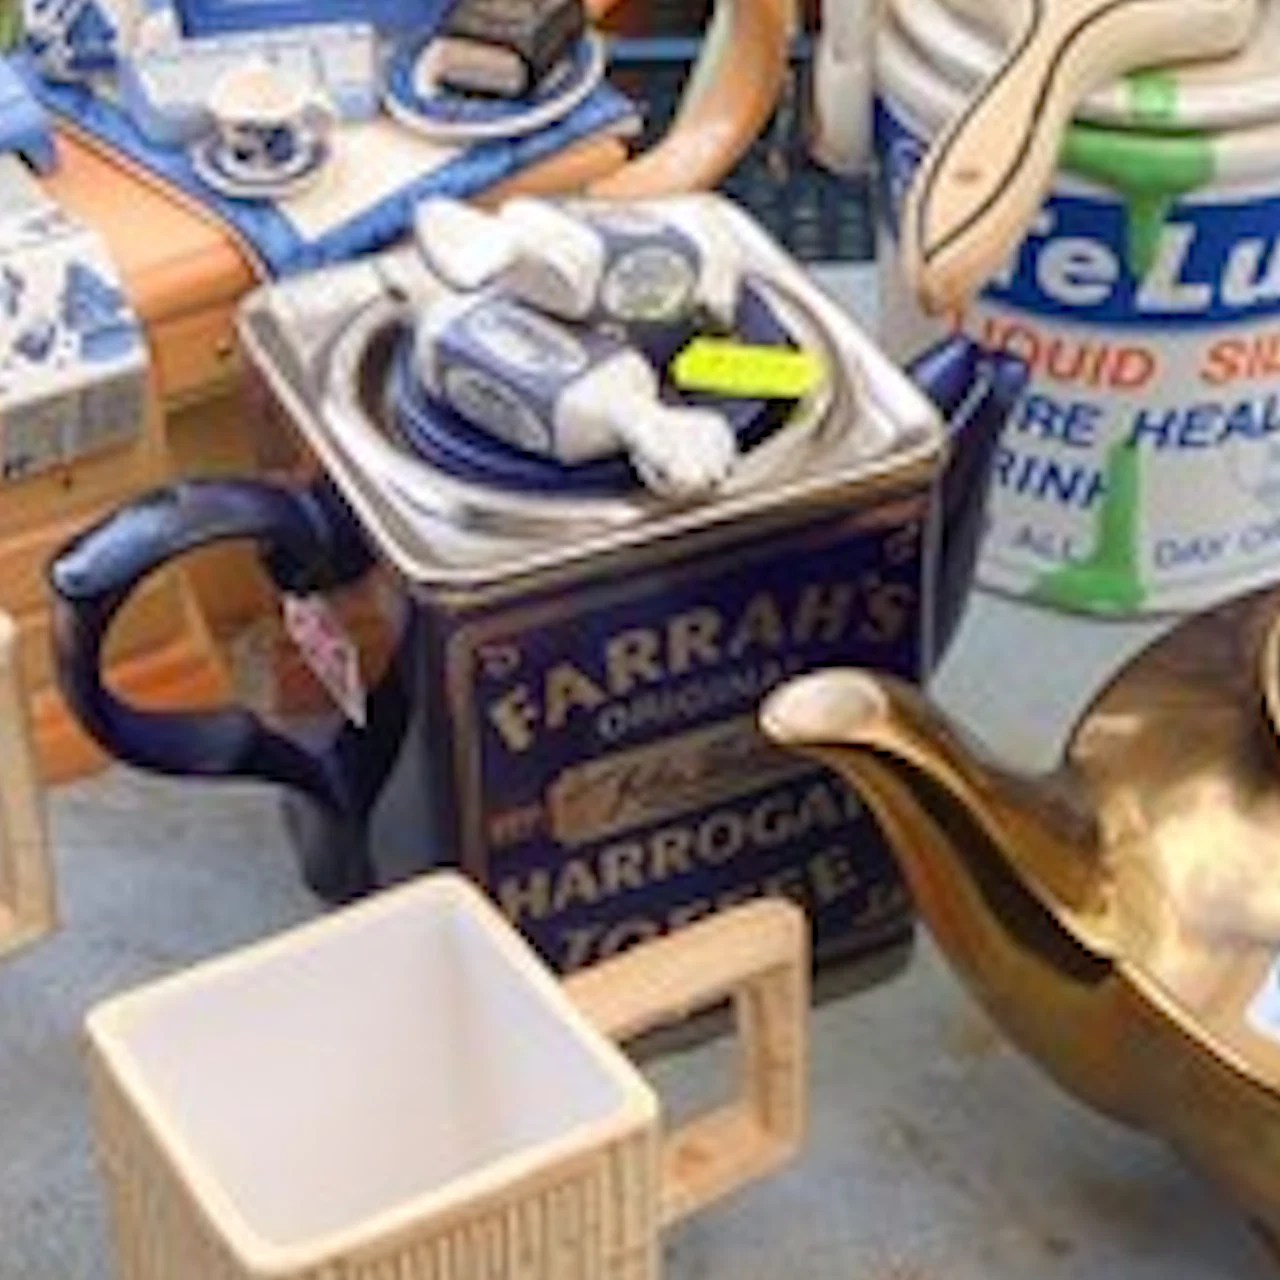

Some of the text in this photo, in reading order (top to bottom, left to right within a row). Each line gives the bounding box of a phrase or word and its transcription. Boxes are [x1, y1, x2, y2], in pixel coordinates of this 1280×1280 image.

[948, 311, 1156, 389] IQUID
[1019, 393, 1104, 448] RE
[488, 573, 918, 754] FARRAH'S
[494, 784, 856, 922] HARROGA
